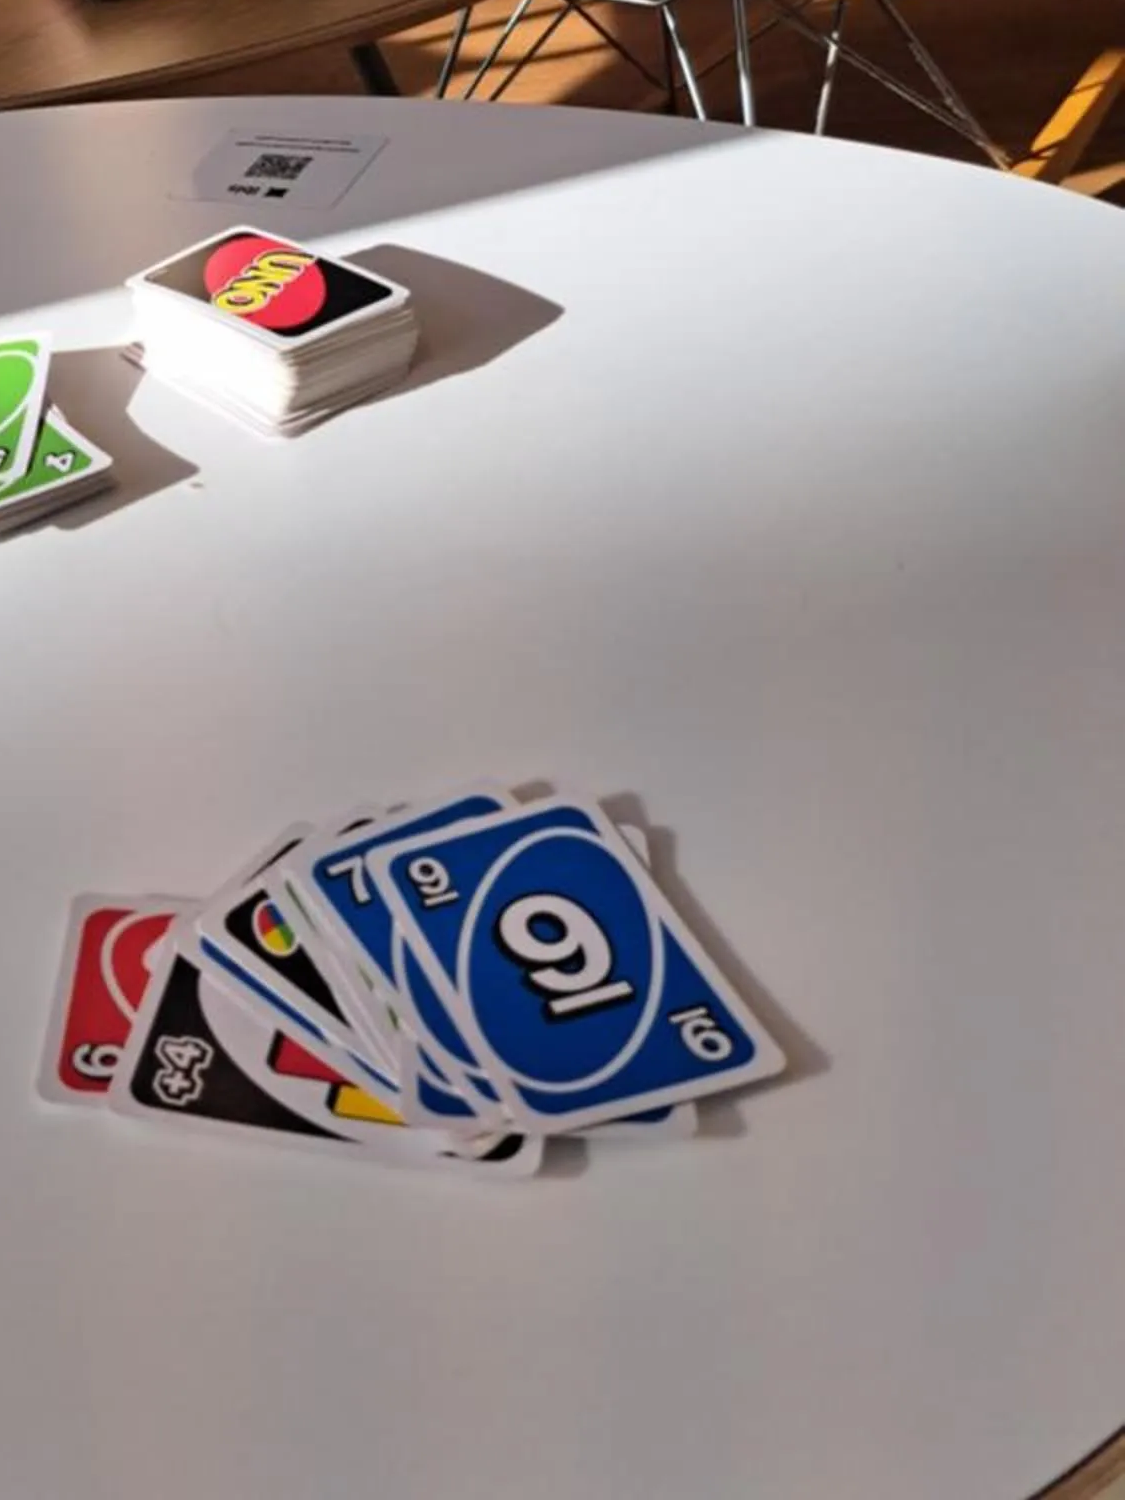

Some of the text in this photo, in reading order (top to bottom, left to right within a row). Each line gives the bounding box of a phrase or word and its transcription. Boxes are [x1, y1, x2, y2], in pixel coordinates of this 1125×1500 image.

[213, 250, 315, 315] UNO
[43, 450, 75, 474] 4
[326, 855, 371, 904] 7
